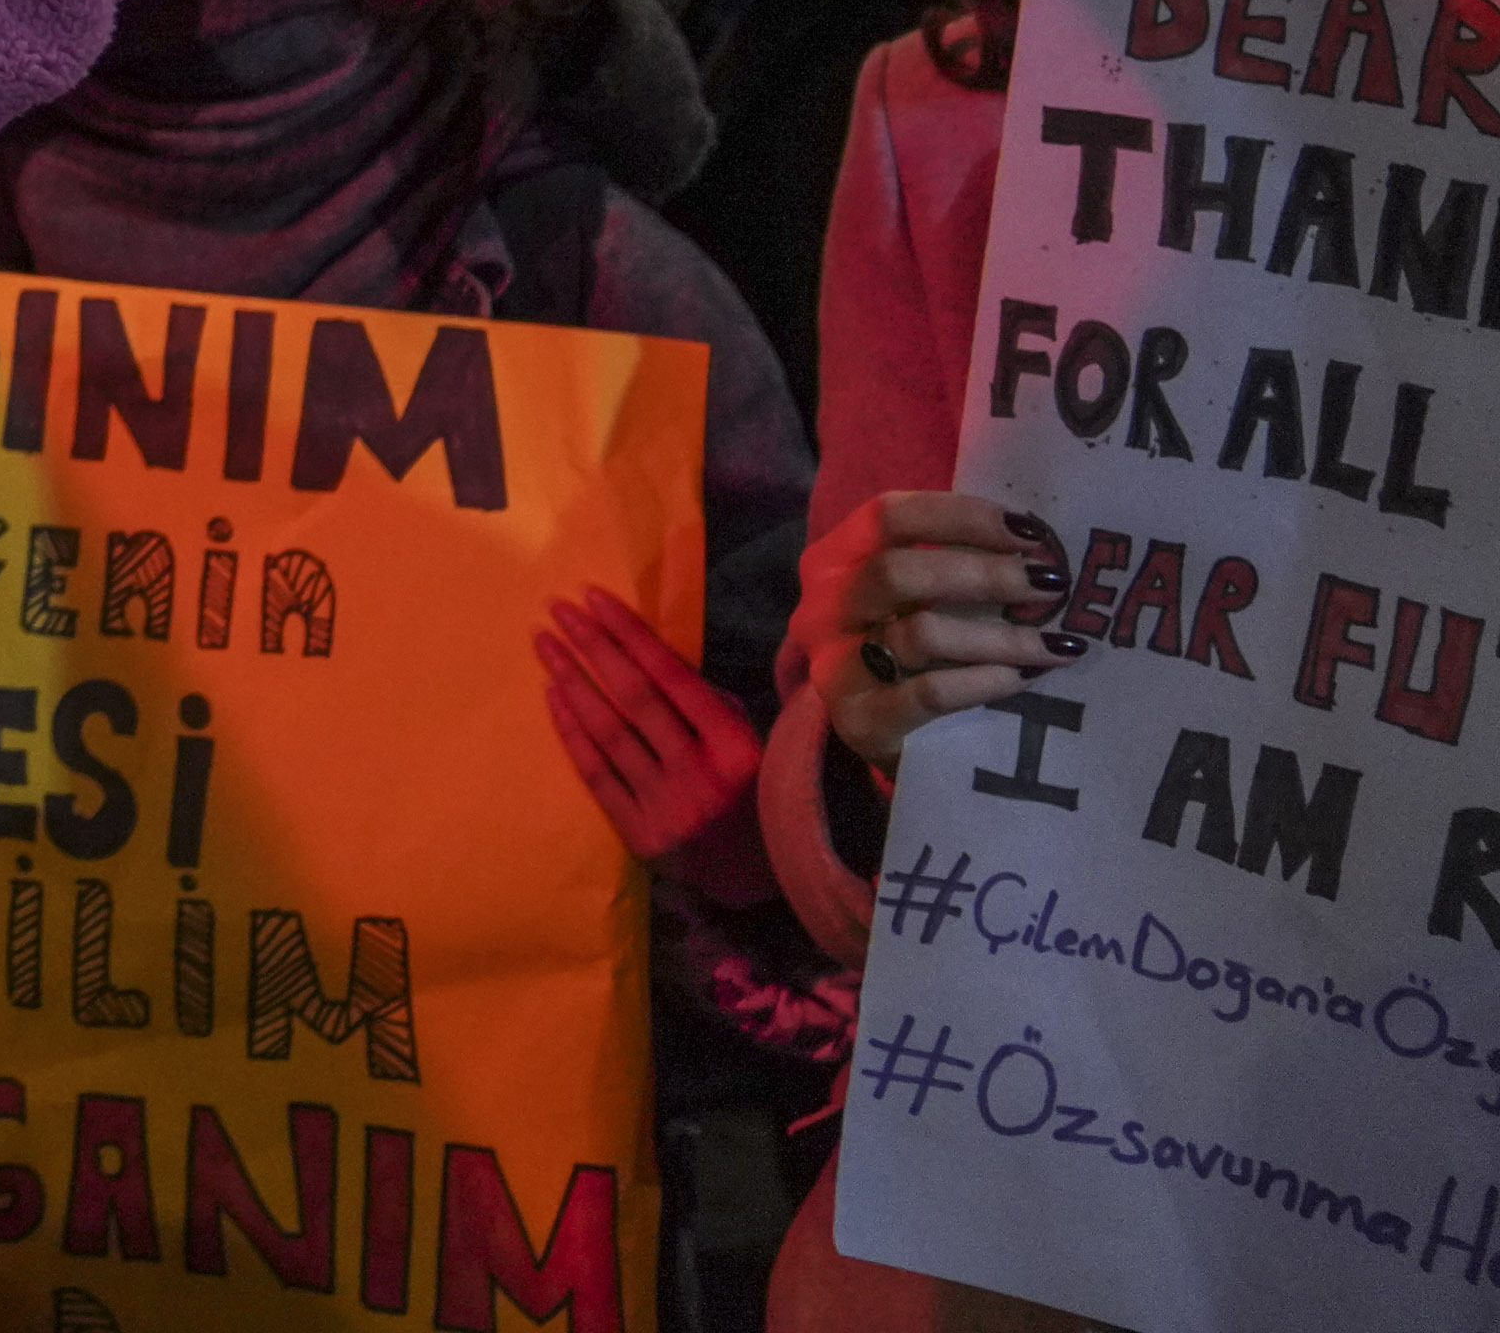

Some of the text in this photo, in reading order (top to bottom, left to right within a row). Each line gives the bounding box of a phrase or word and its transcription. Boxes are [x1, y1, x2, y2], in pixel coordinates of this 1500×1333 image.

[1041, 105, 1500, 331] THAN
[989, 297, 1452, 530] FOR ALL
[1294, 572, 1500, 746] FU
[972, 690, 1086, 812] I
[1141, 727, 1364, 902] AM
